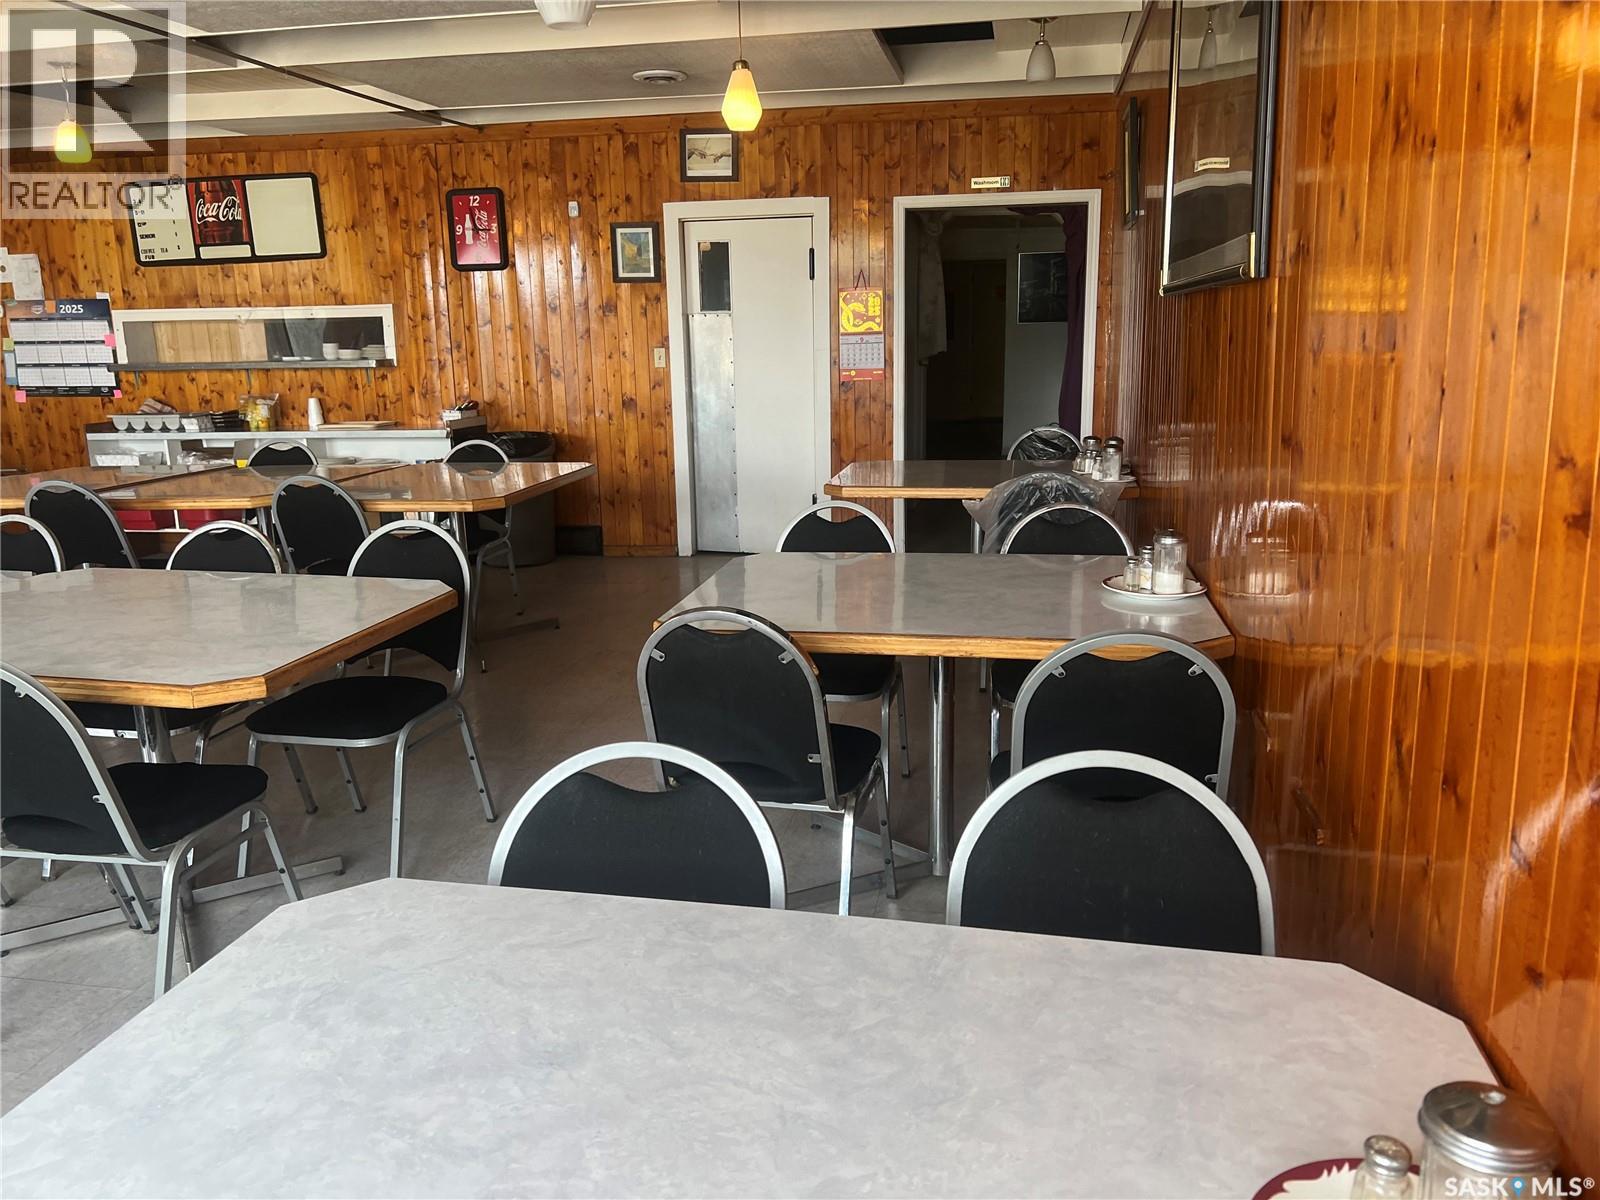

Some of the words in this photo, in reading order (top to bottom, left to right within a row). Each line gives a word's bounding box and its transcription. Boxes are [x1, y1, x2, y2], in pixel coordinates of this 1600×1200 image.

[469, 195, 480, 207] 12
[196, 196, 242, 225] Coca-Cola
[455, 225, 463, 235] 9
[490, 224, 498, 234] 3
[59, 304, 84, 314] 2025
